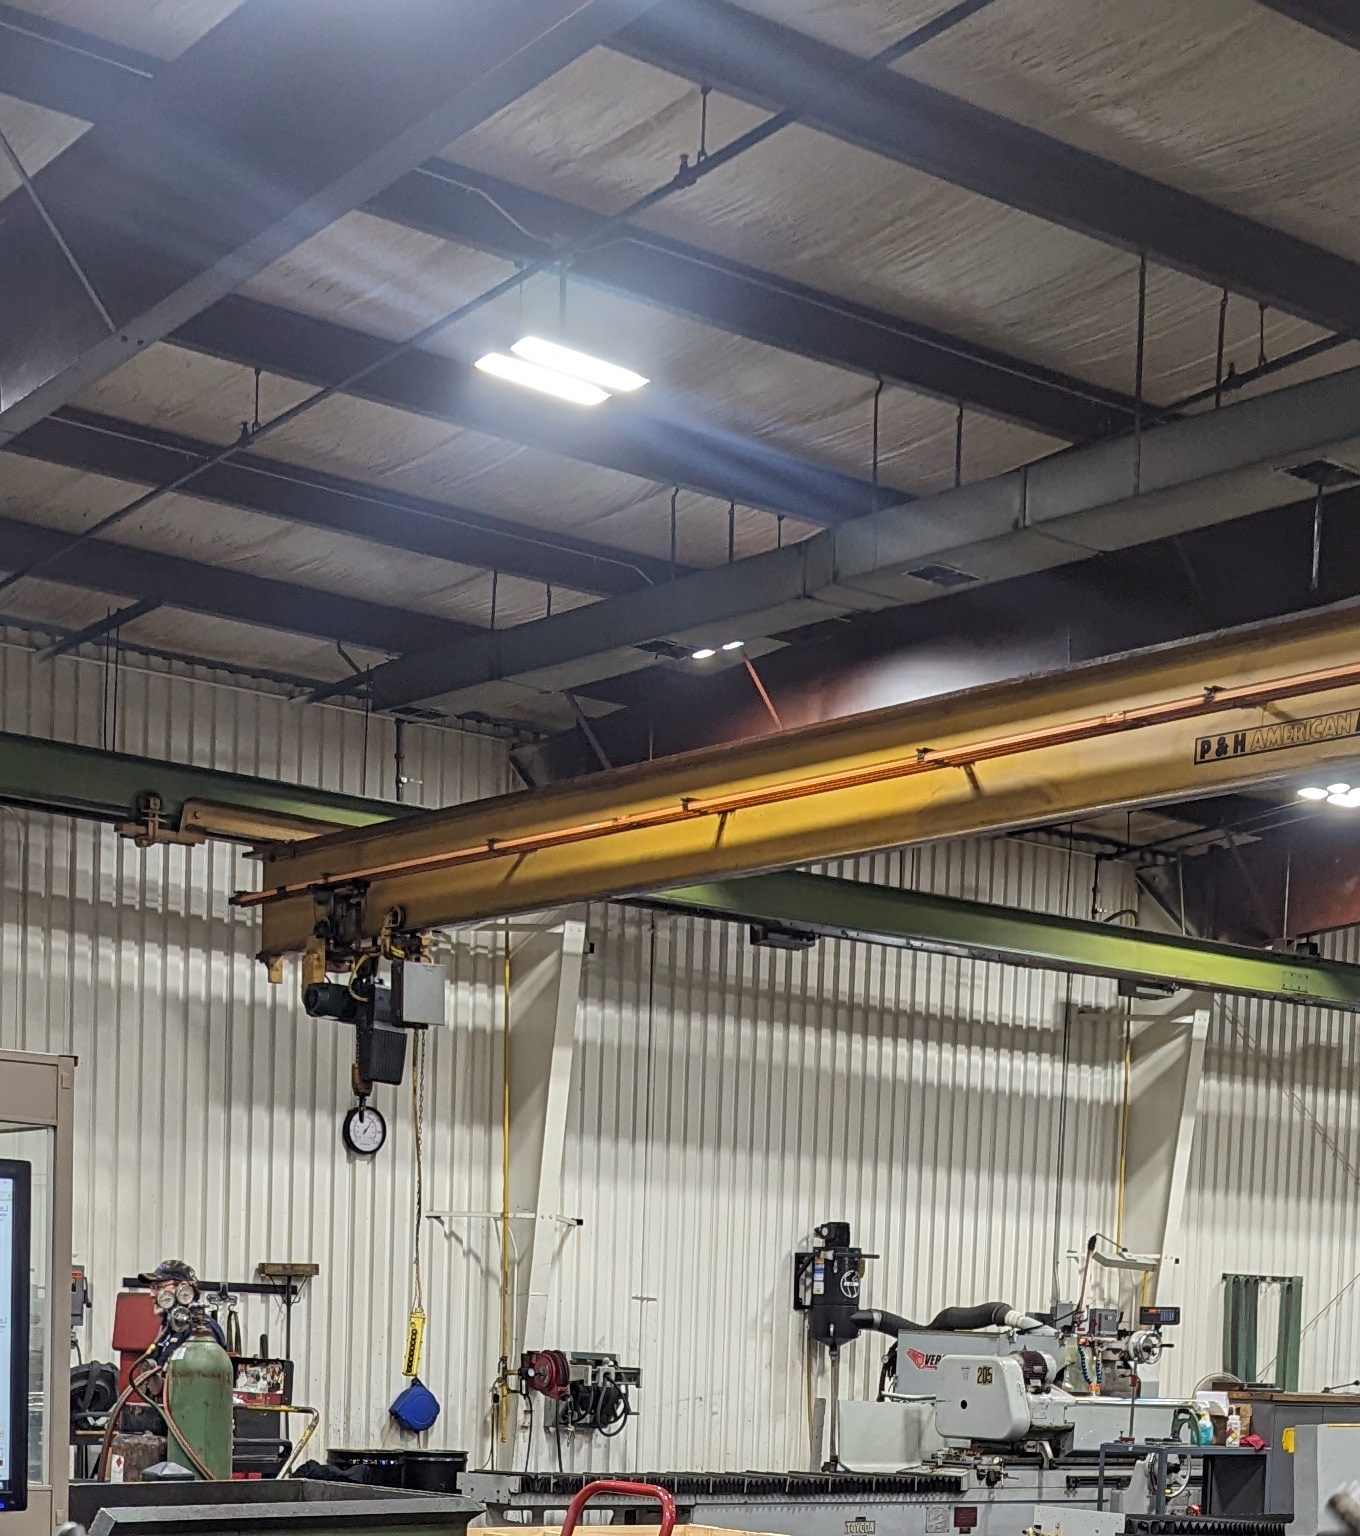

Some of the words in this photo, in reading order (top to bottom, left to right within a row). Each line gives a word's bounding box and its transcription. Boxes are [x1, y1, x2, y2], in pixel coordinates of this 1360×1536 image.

[1199, 739, 1212, 760] P
[1215, 738, 1229, 757] &
[1233, 733, 1246, 754] H
[1250, 713, 1352, 752] AMERICAN
[925, 1354, 946, 1366] VER
[977, 1366, 993, 1384] 205
